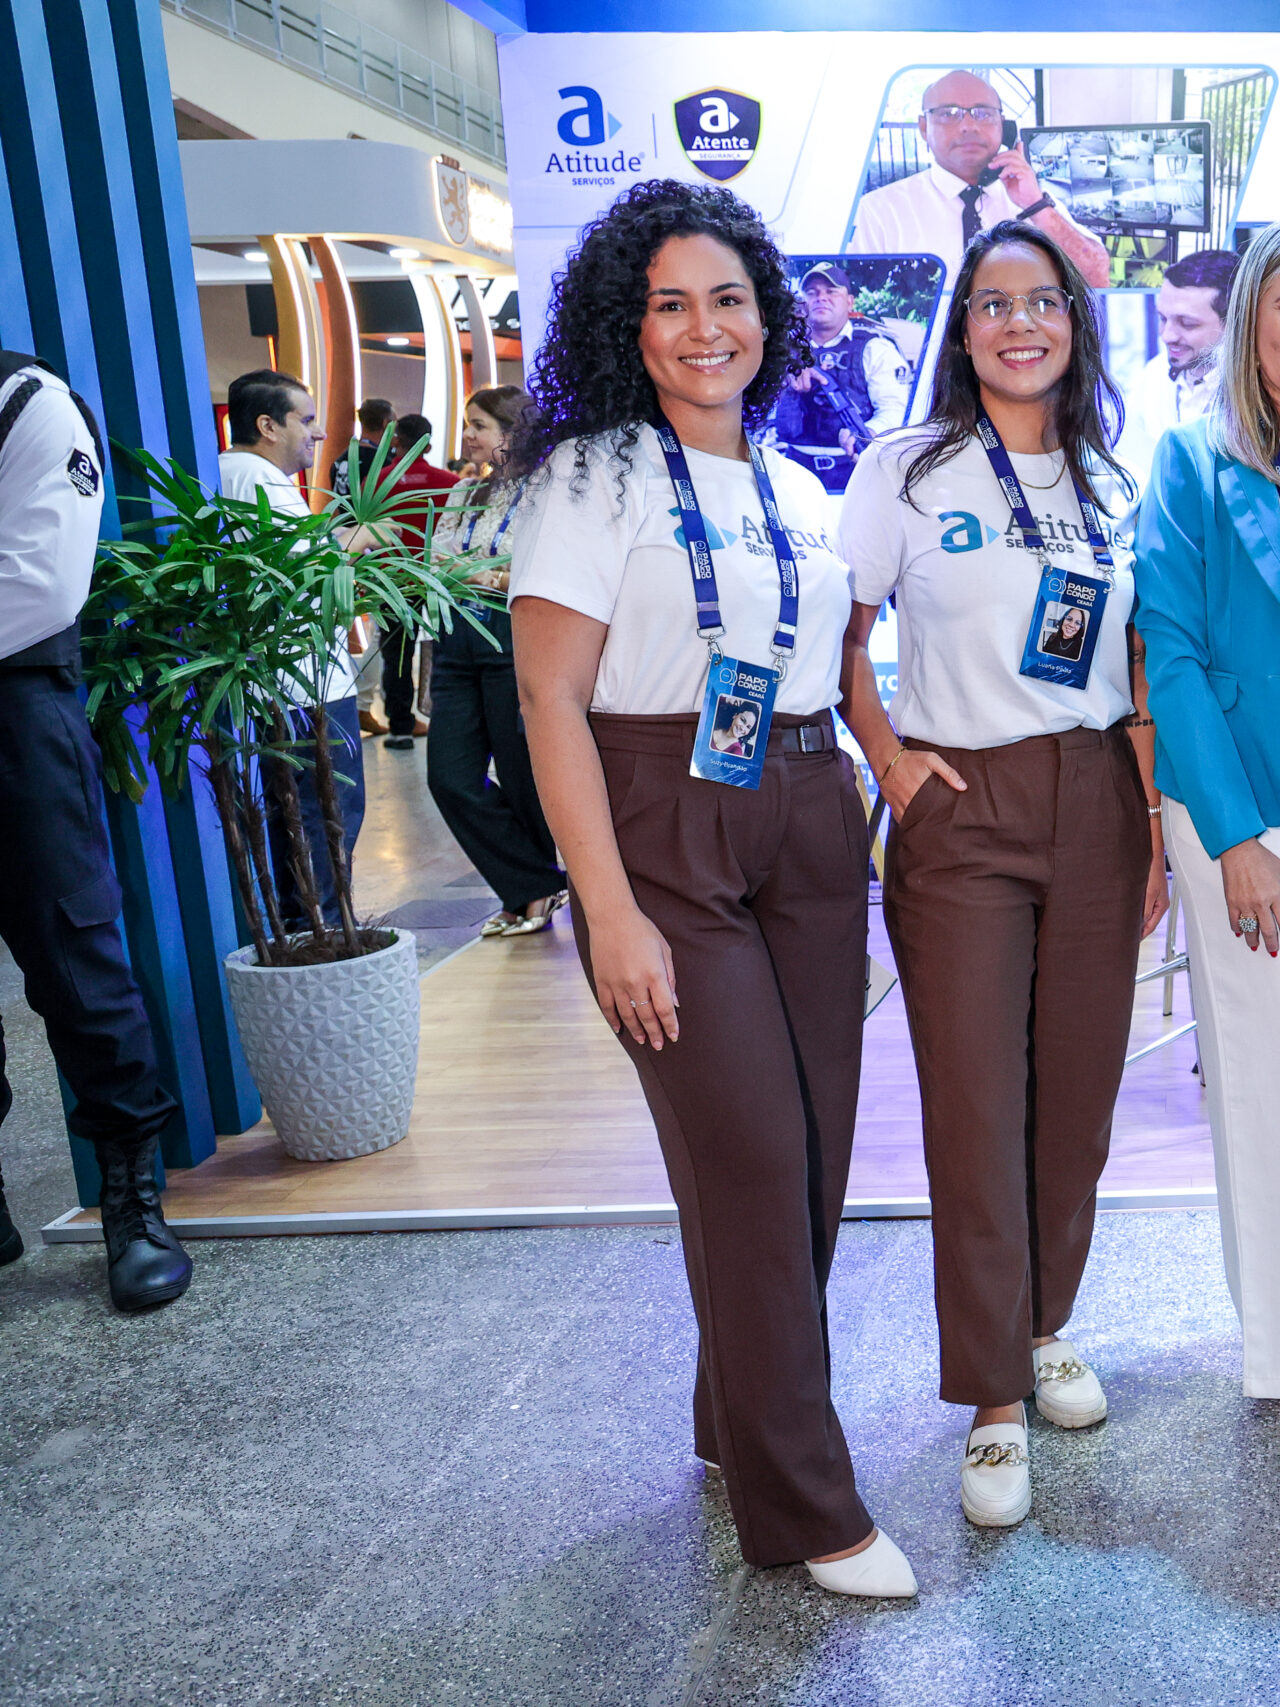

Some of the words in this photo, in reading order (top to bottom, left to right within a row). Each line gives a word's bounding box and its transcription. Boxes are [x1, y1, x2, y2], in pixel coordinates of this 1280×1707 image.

[692, 136, 750, 150] Atente
[545, 151, 642, 173] Atitude
[572, 177, 615, 187] SERVIÇOS
[987, 427, 999, 448] PAPO
[686, 490, 696, 511] PAPO
[1013, 487, 1024, 508] PAPO
[702, 552, 712, 579] PAPO
[780, 559, 788, 582] PAPO
[1066, 589, 1096, 602] CONDO
[1067, 582, 1097, 596] PAPO
[1077, 599, 1093, 607] CEARÁ
[737, 680, 767, 693] CONDO
[738, 672, 768, 687] PAPO
[748, 691, 765, 700] CEARÁ
